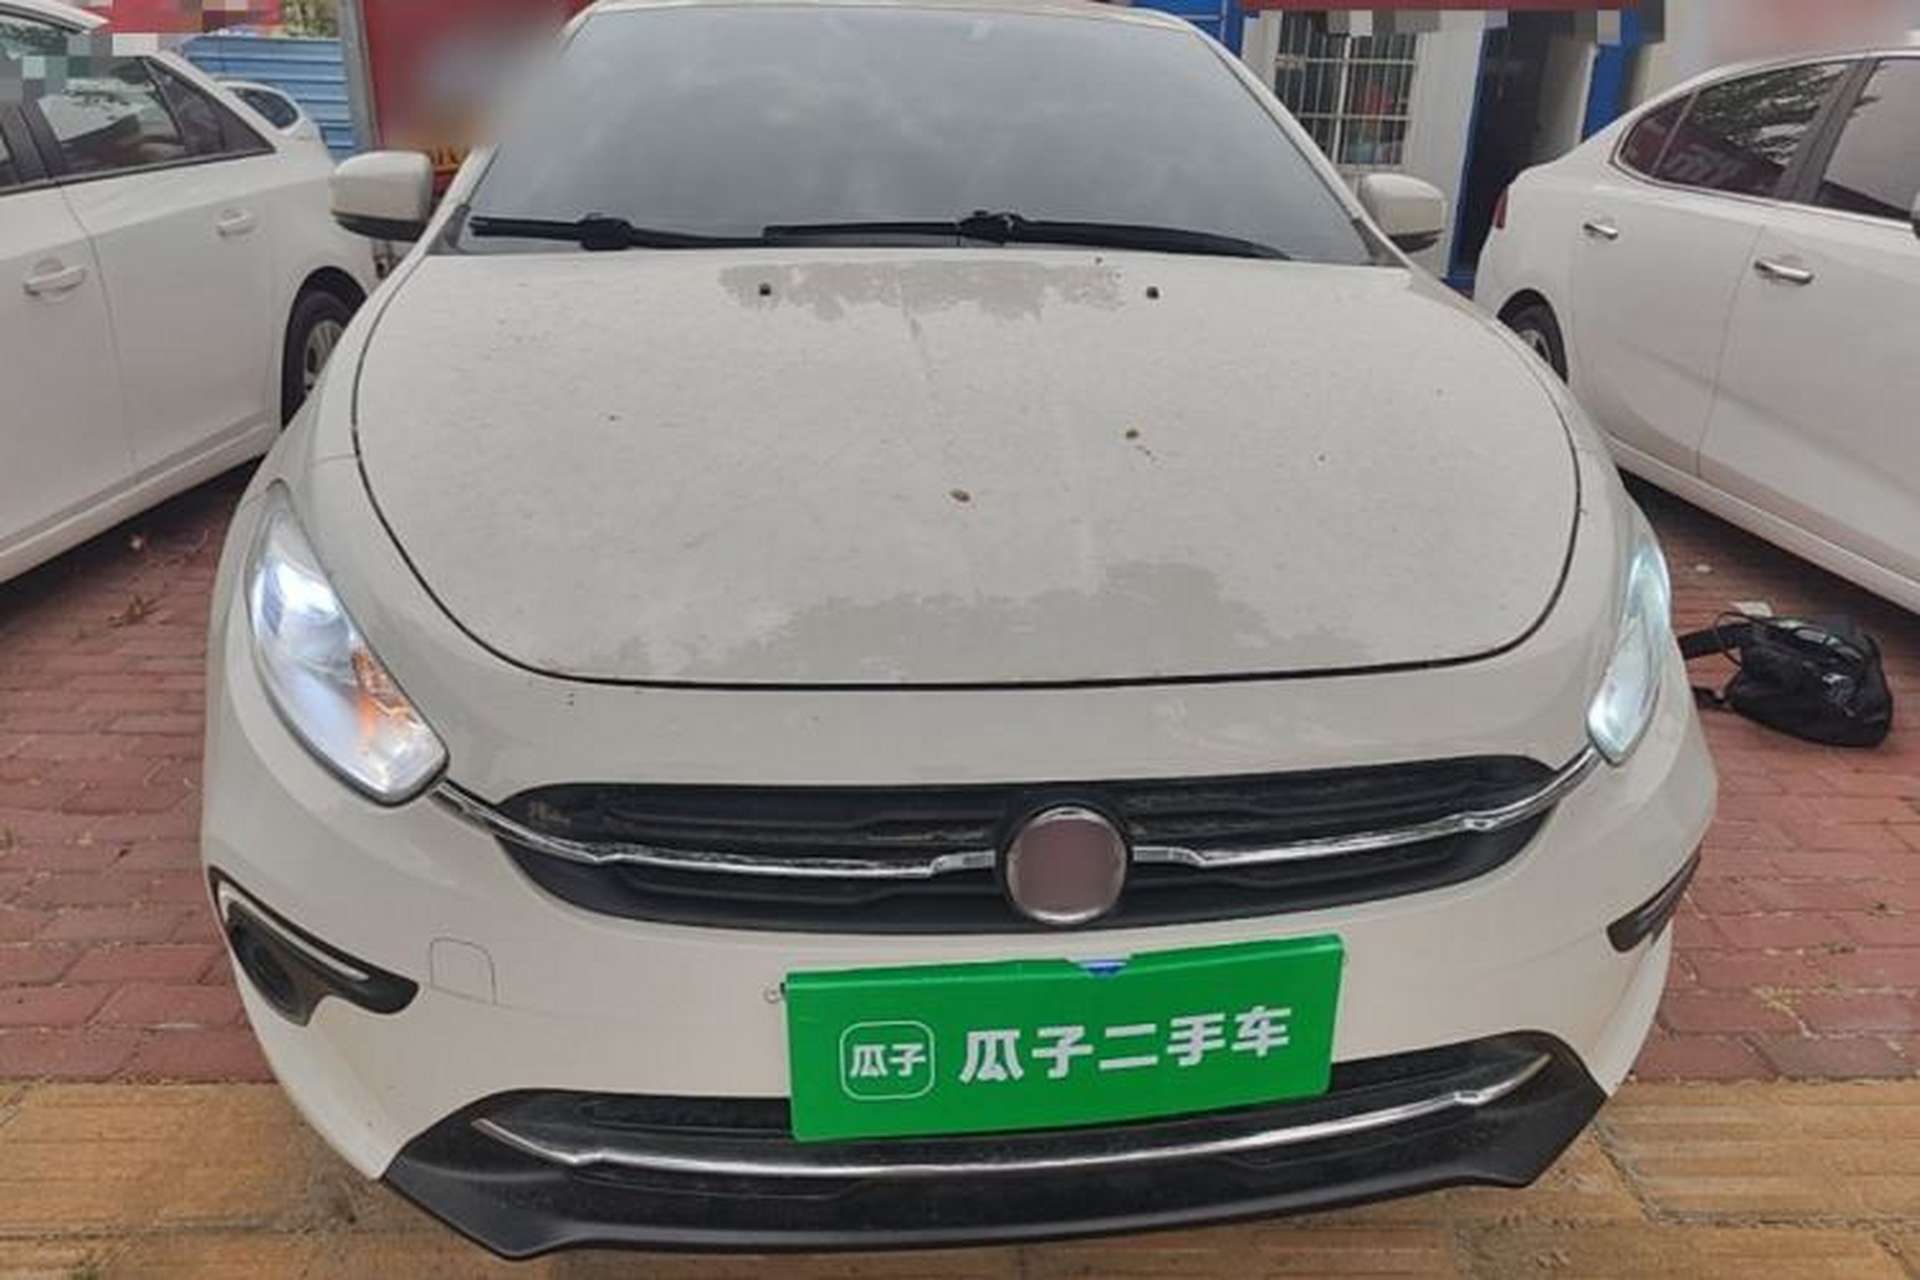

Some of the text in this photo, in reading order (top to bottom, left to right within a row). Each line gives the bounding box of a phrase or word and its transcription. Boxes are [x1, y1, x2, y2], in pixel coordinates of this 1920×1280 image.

[849, 1042, 927, 1078] 瓜子
[959, 1005, 1292, 1083] 瓜子二手车
